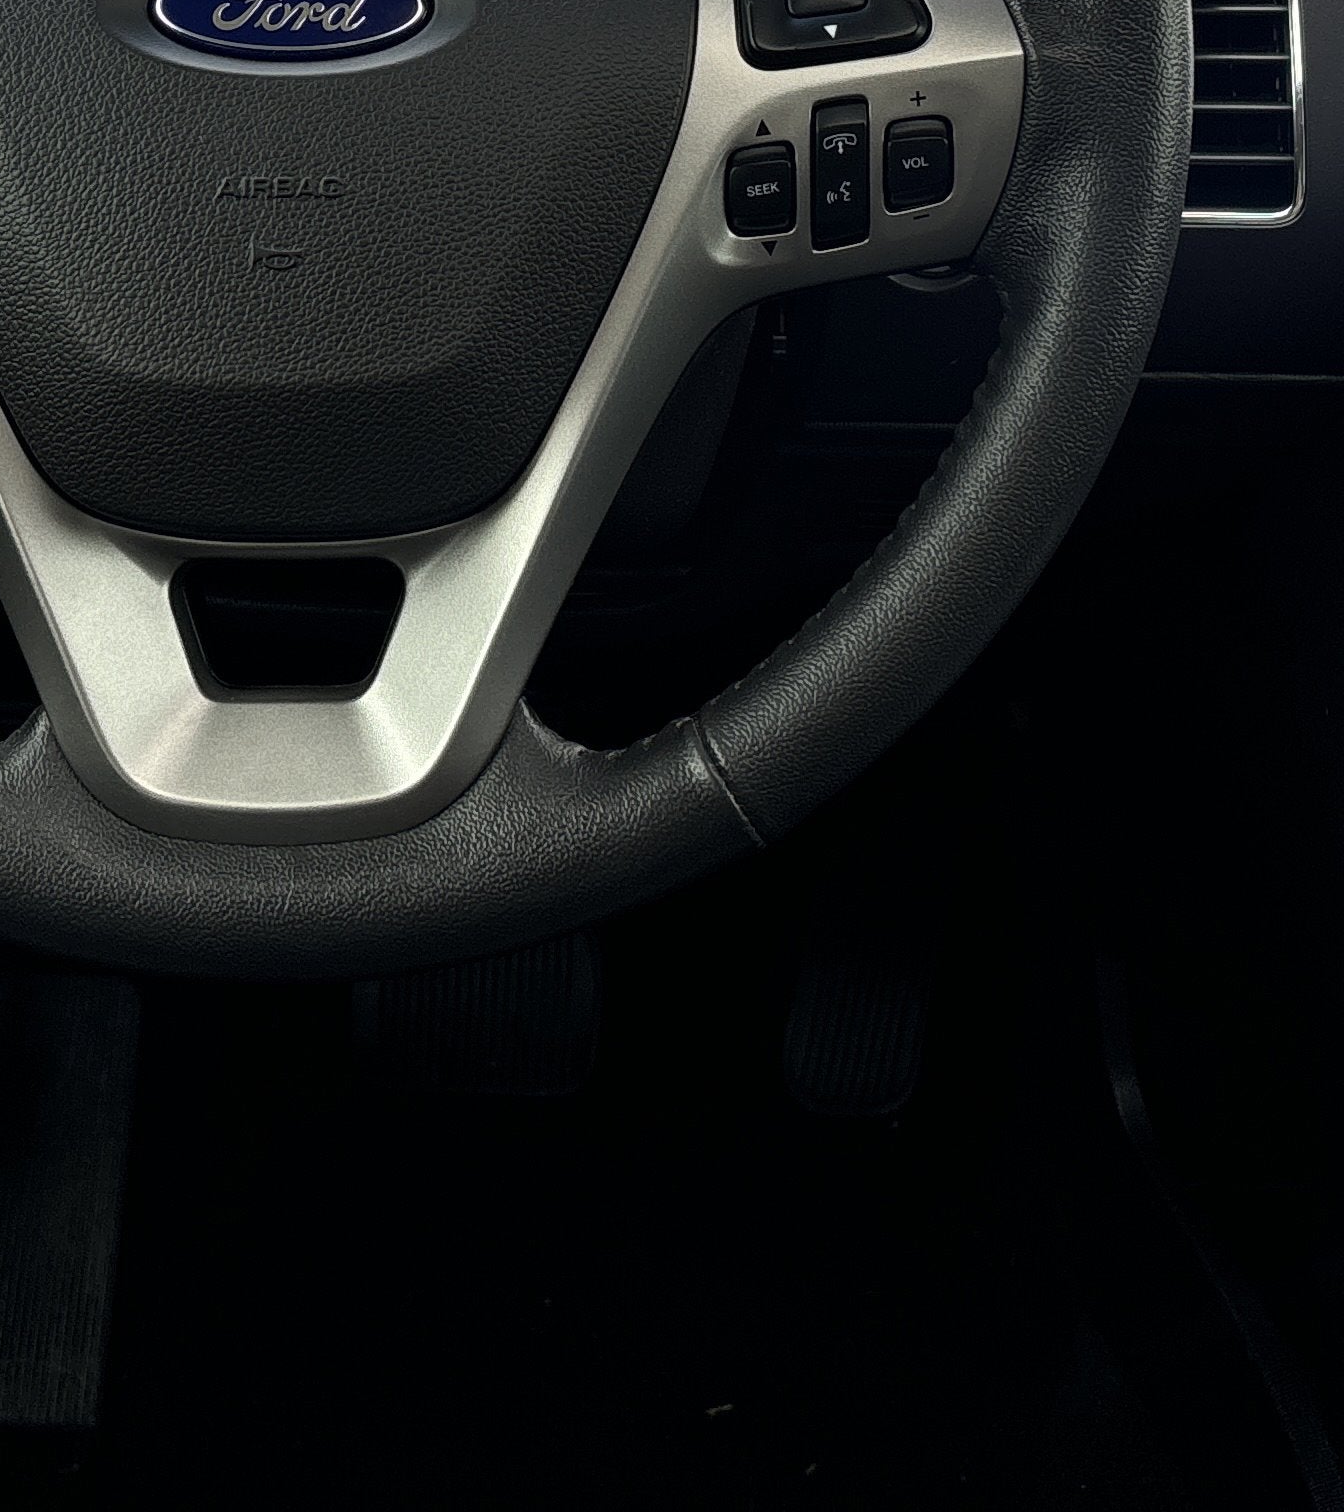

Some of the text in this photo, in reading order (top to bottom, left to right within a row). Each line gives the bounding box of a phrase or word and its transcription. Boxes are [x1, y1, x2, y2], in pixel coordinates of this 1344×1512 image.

[902, 157, 928, 169] VOL
[215, 178, 346, 199] AIRBAG
[747, 182, 779, 197] SEEK
